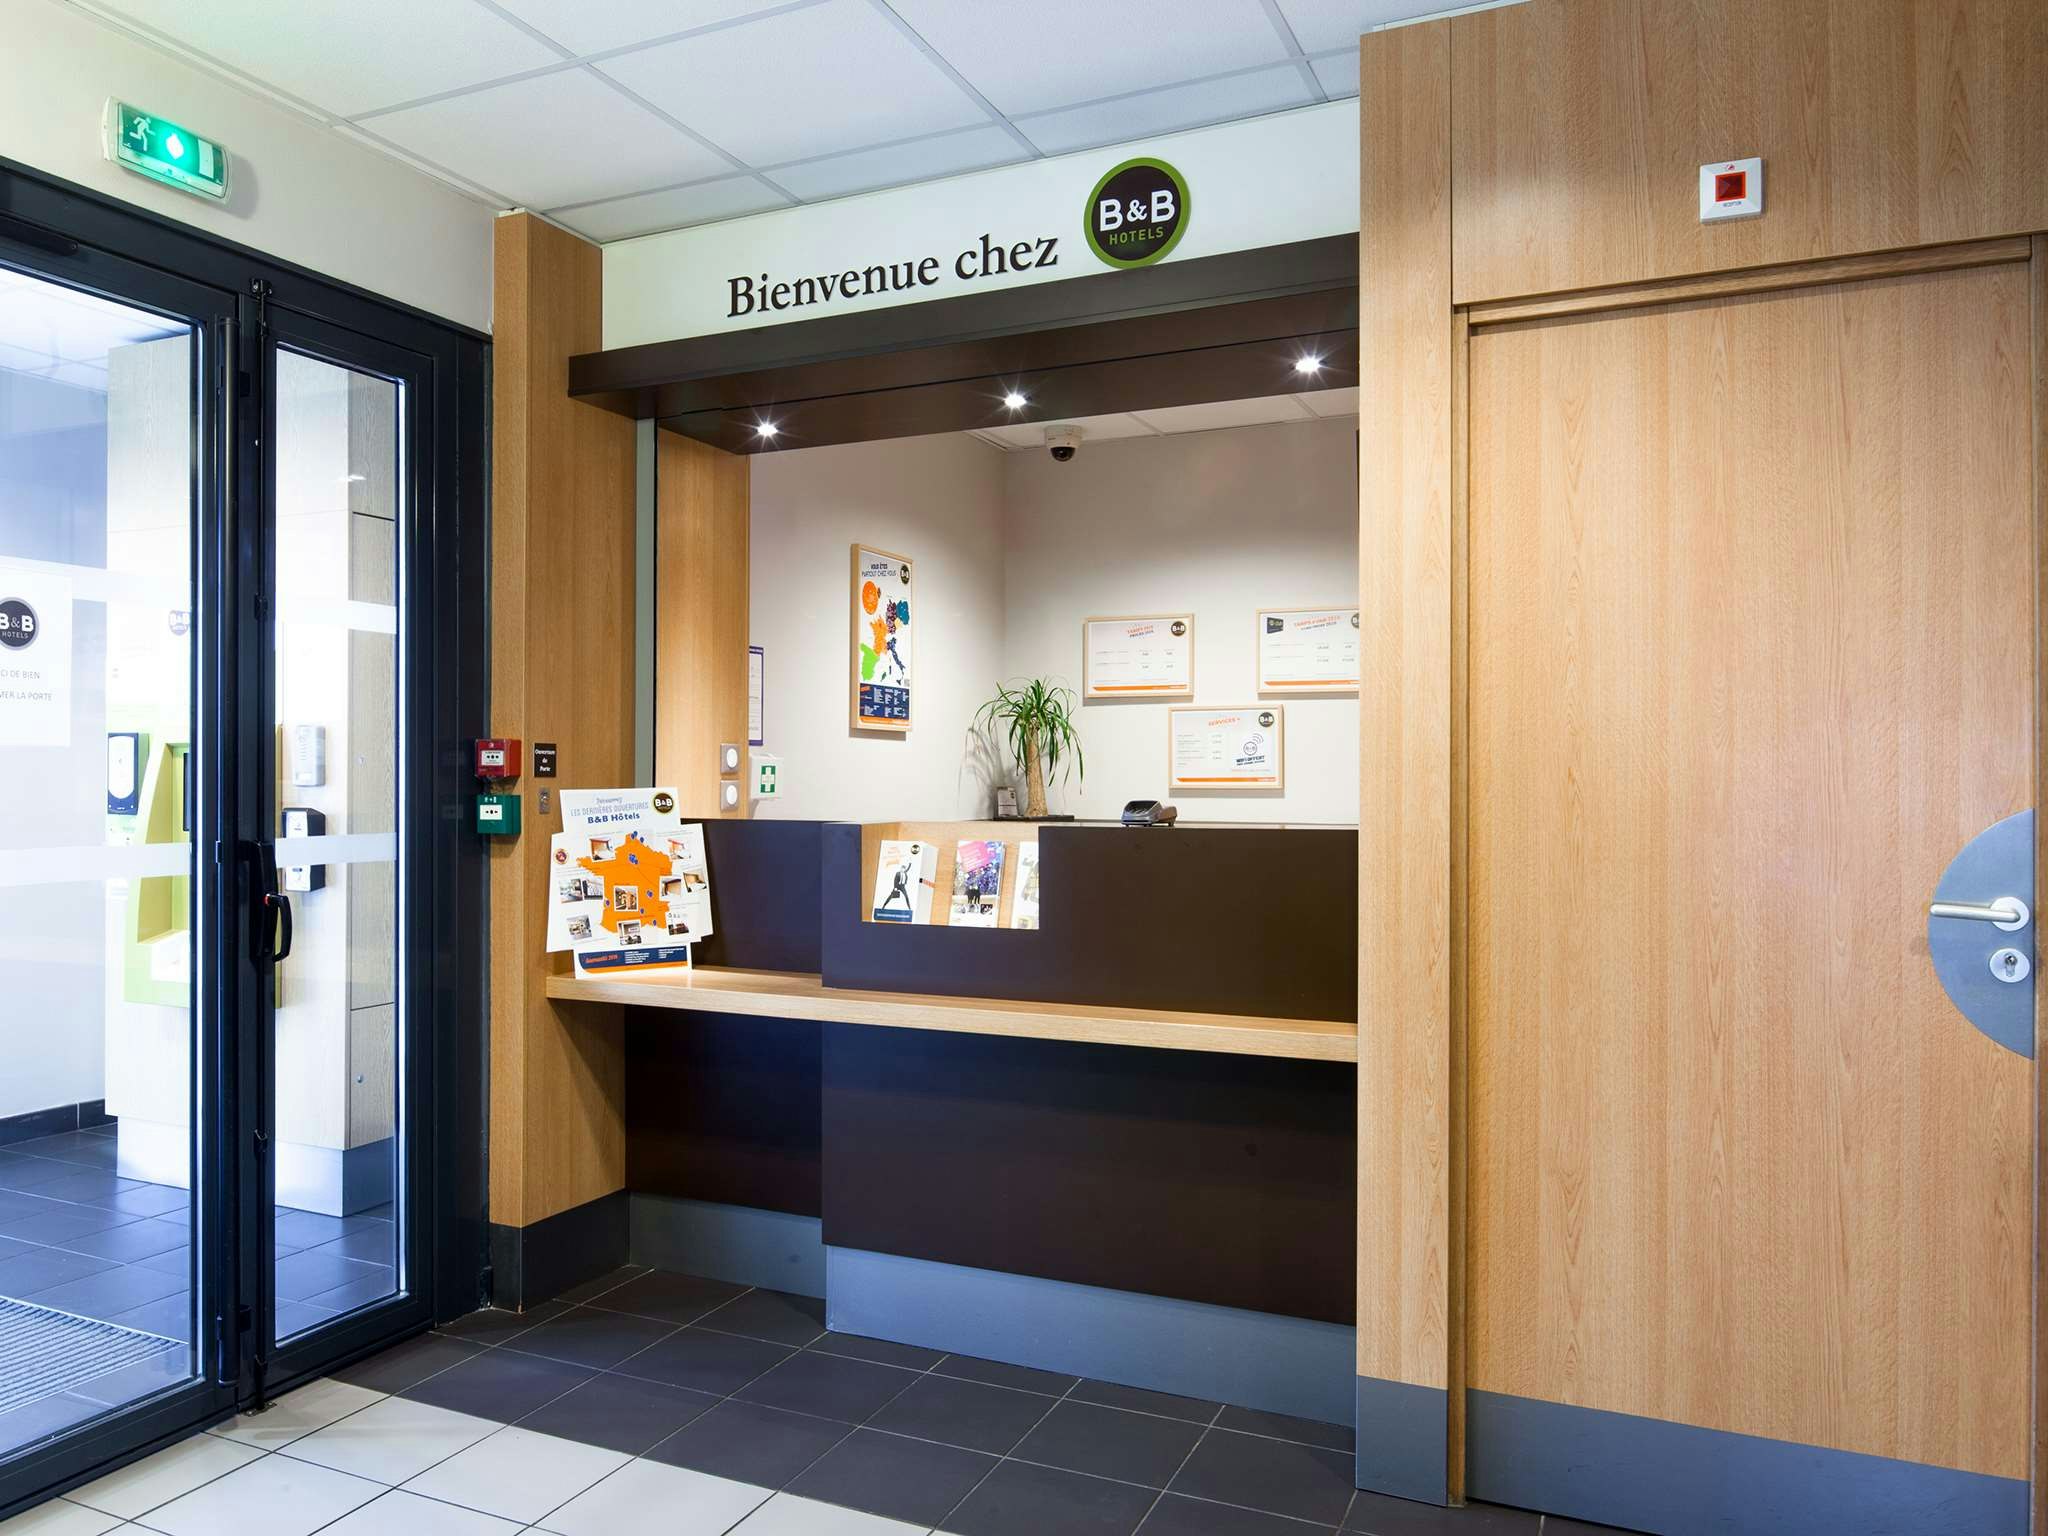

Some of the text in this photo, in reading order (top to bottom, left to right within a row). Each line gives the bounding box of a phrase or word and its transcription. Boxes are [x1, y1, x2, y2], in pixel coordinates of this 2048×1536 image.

[1100, 189, 1175, 232] B&B
[1109, 226, 1165, 246] HOTELS
[727, 233, 1059, 318] Bienvenue chez
[0, 613, 34, 632] B&B
[2, 631, 29, 639] HOTELS
[10, 670, 20, 679] DE
[22, 671, 40, 680] BIEN
[17, 691, 26, 700] LA
[28, 692, 52, 701] PORTE
[614, 801, 649, 812] OUVERTURES
[655, 798, 672, 807] B&B
[587, 812, 640, 824] B&B Hôtels
